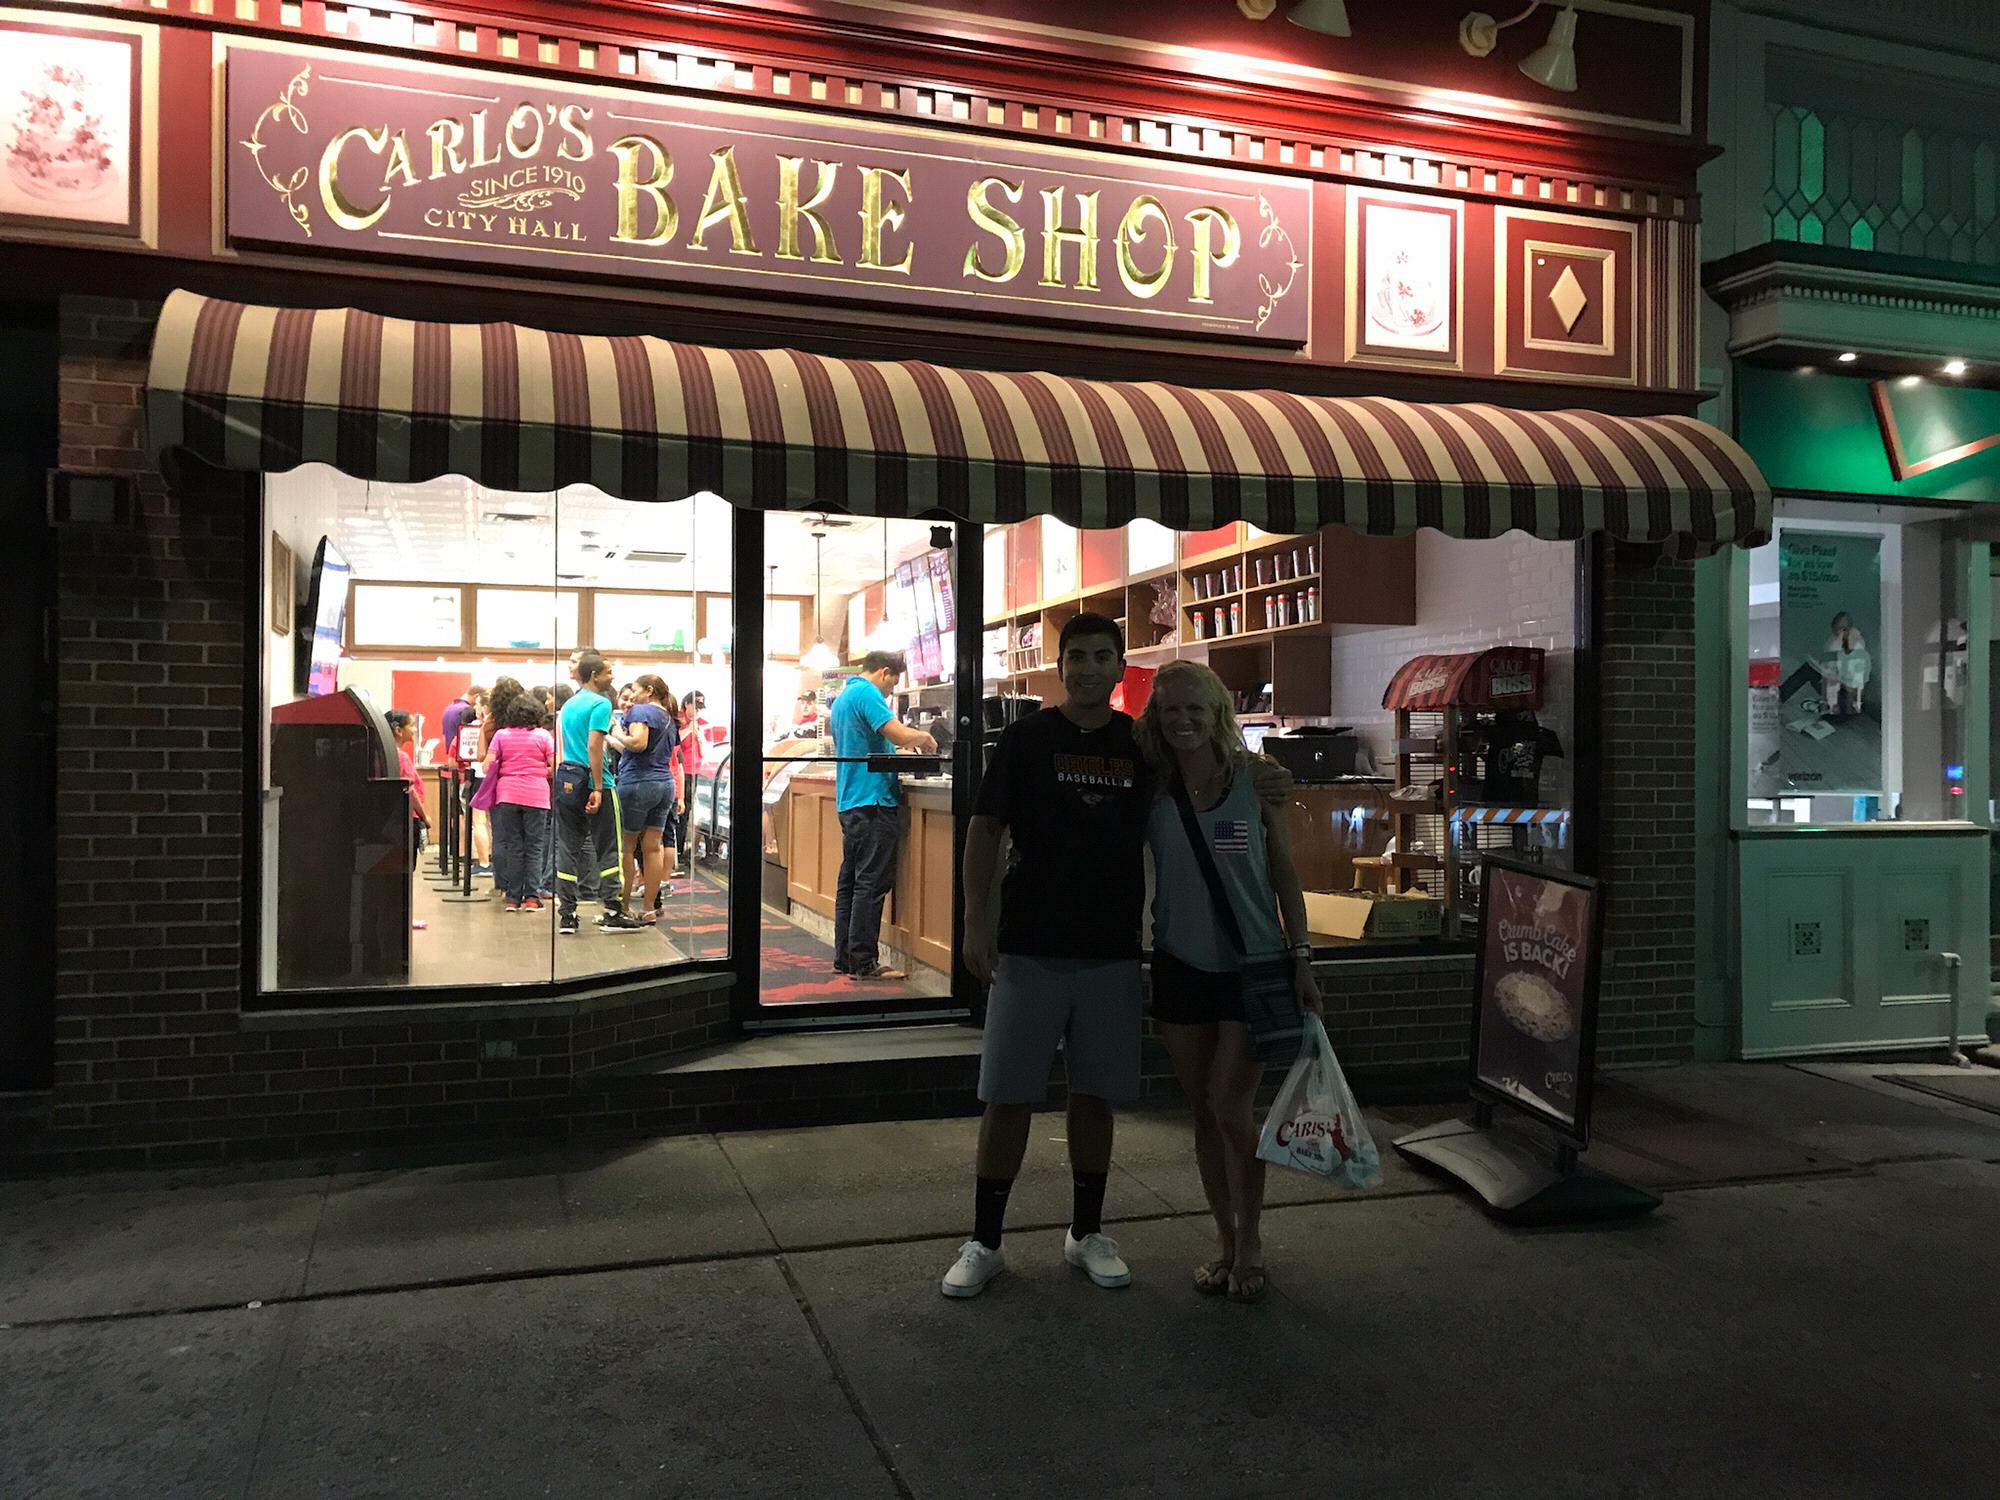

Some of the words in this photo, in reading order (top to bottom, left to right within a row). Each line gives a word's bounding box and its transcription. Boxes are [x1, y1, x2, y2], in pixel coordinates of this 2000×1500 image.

[318, 102, 594, 231] CARLO'S
[470, 165, 537, 197] SINCE
[543, 165, 586, 193] 1910
[424, 208, 497, 232] CITY
[508, 216, 587, 241] HALL
[606, 134, 915, 275] BAKE
[963, 177, 1241, 304] SHOP
[1057, 772, 1118, 786] BASEBALL
[1499, 919, 1542, 941] Crumb
[1544, 925, 1576, 962] Cake
[1504, 942, 1518, 962] IS
[1521, 942, 1569, 980] BACK!
